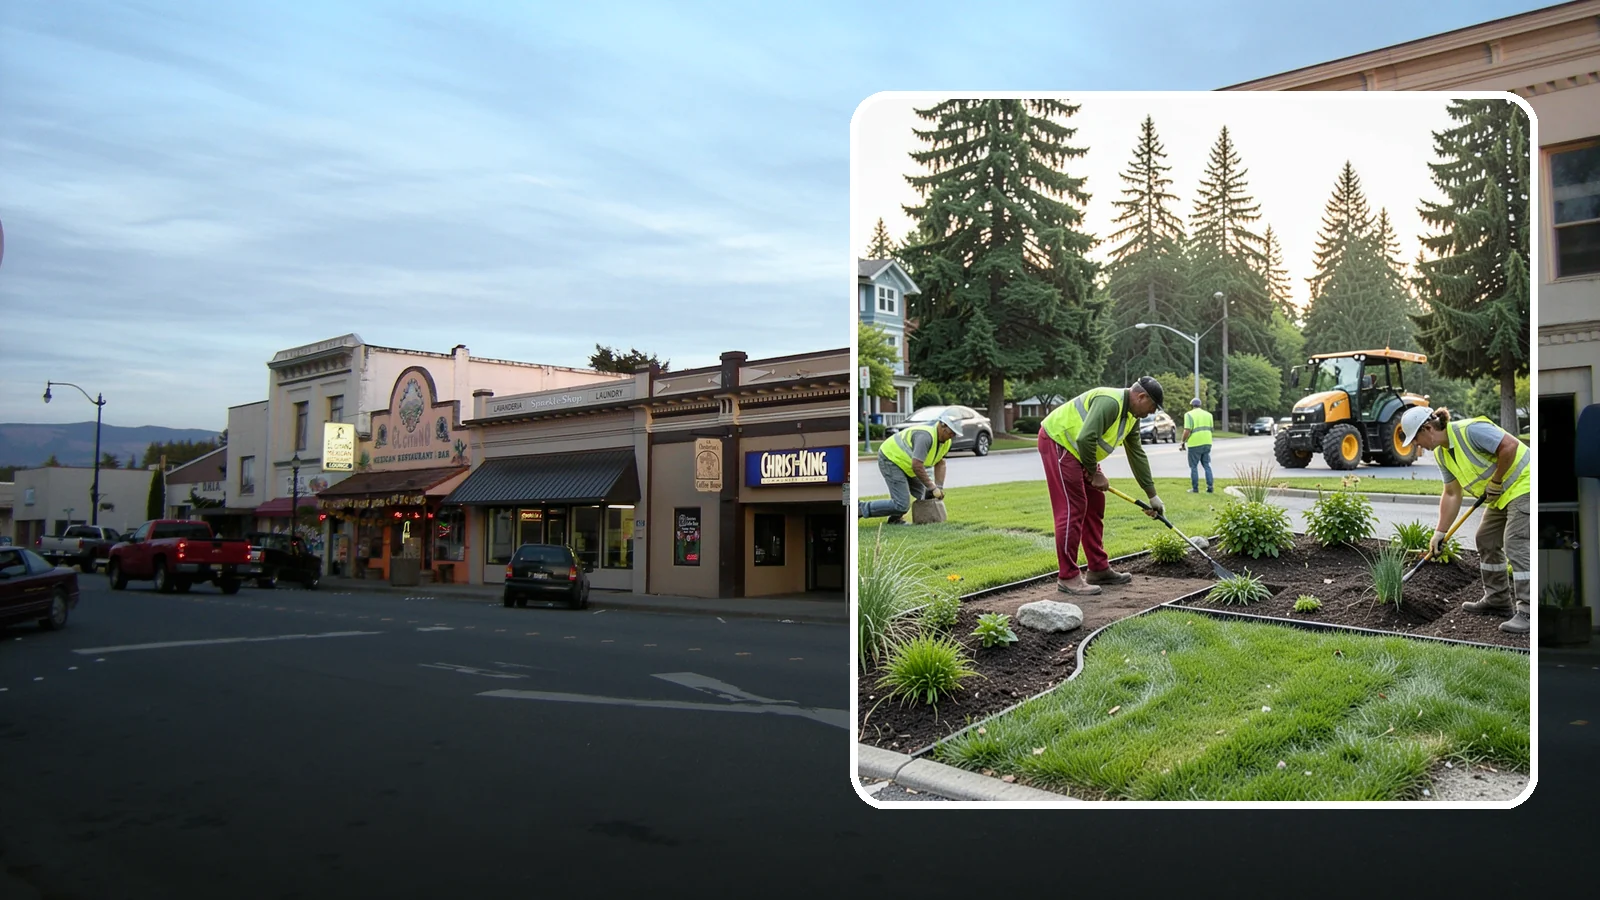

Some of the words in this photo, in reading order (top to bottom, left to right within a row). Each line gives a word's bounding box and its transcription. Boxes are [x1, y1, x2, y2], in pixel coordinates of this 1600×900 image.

[494, 402, 522, 412] LAVANDERIA
[562, 394, 582, 404] Shop
[595, 388, 624, 400] LAUNDRY
[374, 454, 396, 464] MEXICAN
[398, 451, 434, 462] RESTAURANT
[438, 450, 450, 458] BAR
[761, 452, 798, 478] CHRIST
[799, 450, 828, 476] KING
